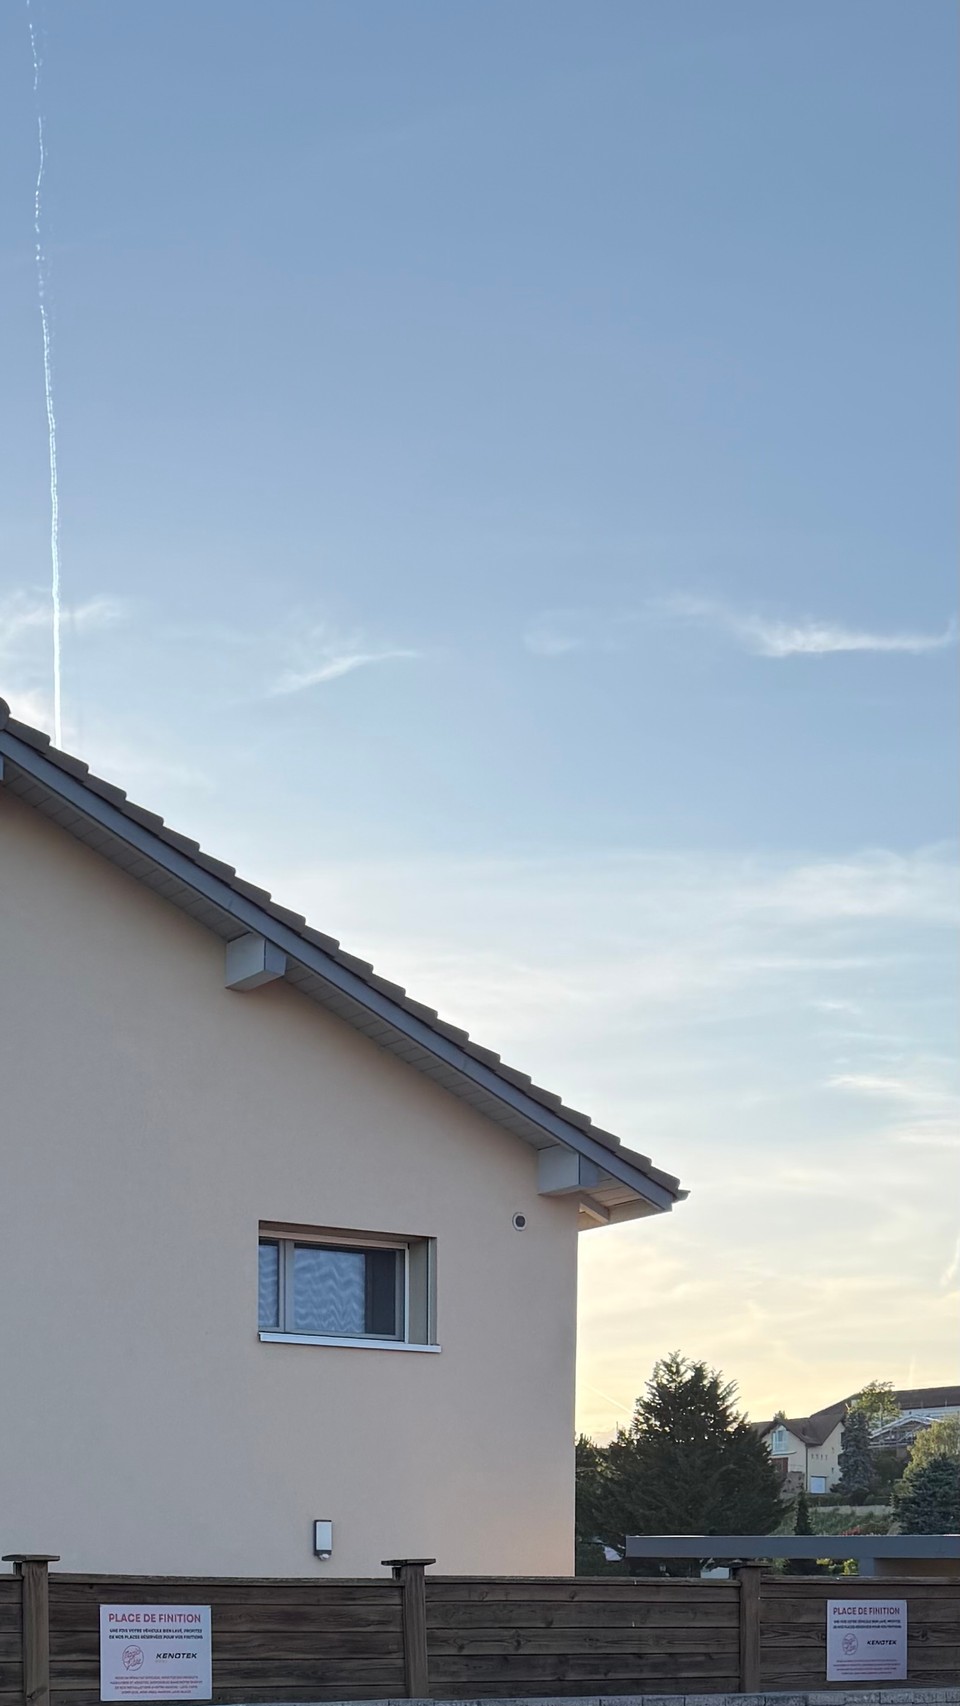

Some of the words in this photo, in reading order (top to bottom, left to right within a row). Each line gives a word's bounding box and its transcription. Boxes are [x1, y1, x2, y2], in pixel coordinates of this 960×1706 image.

[833, 1607, 857, 1615] PLACE
[858, 1607, 868, 1615] DE
[869, 1607, 900, 1615] FINITION
[108, 1613, 141, 1623] PLACE
[143, 1613, 157, 1623] DE
[158, 1613, 201, 1624] FINITION
